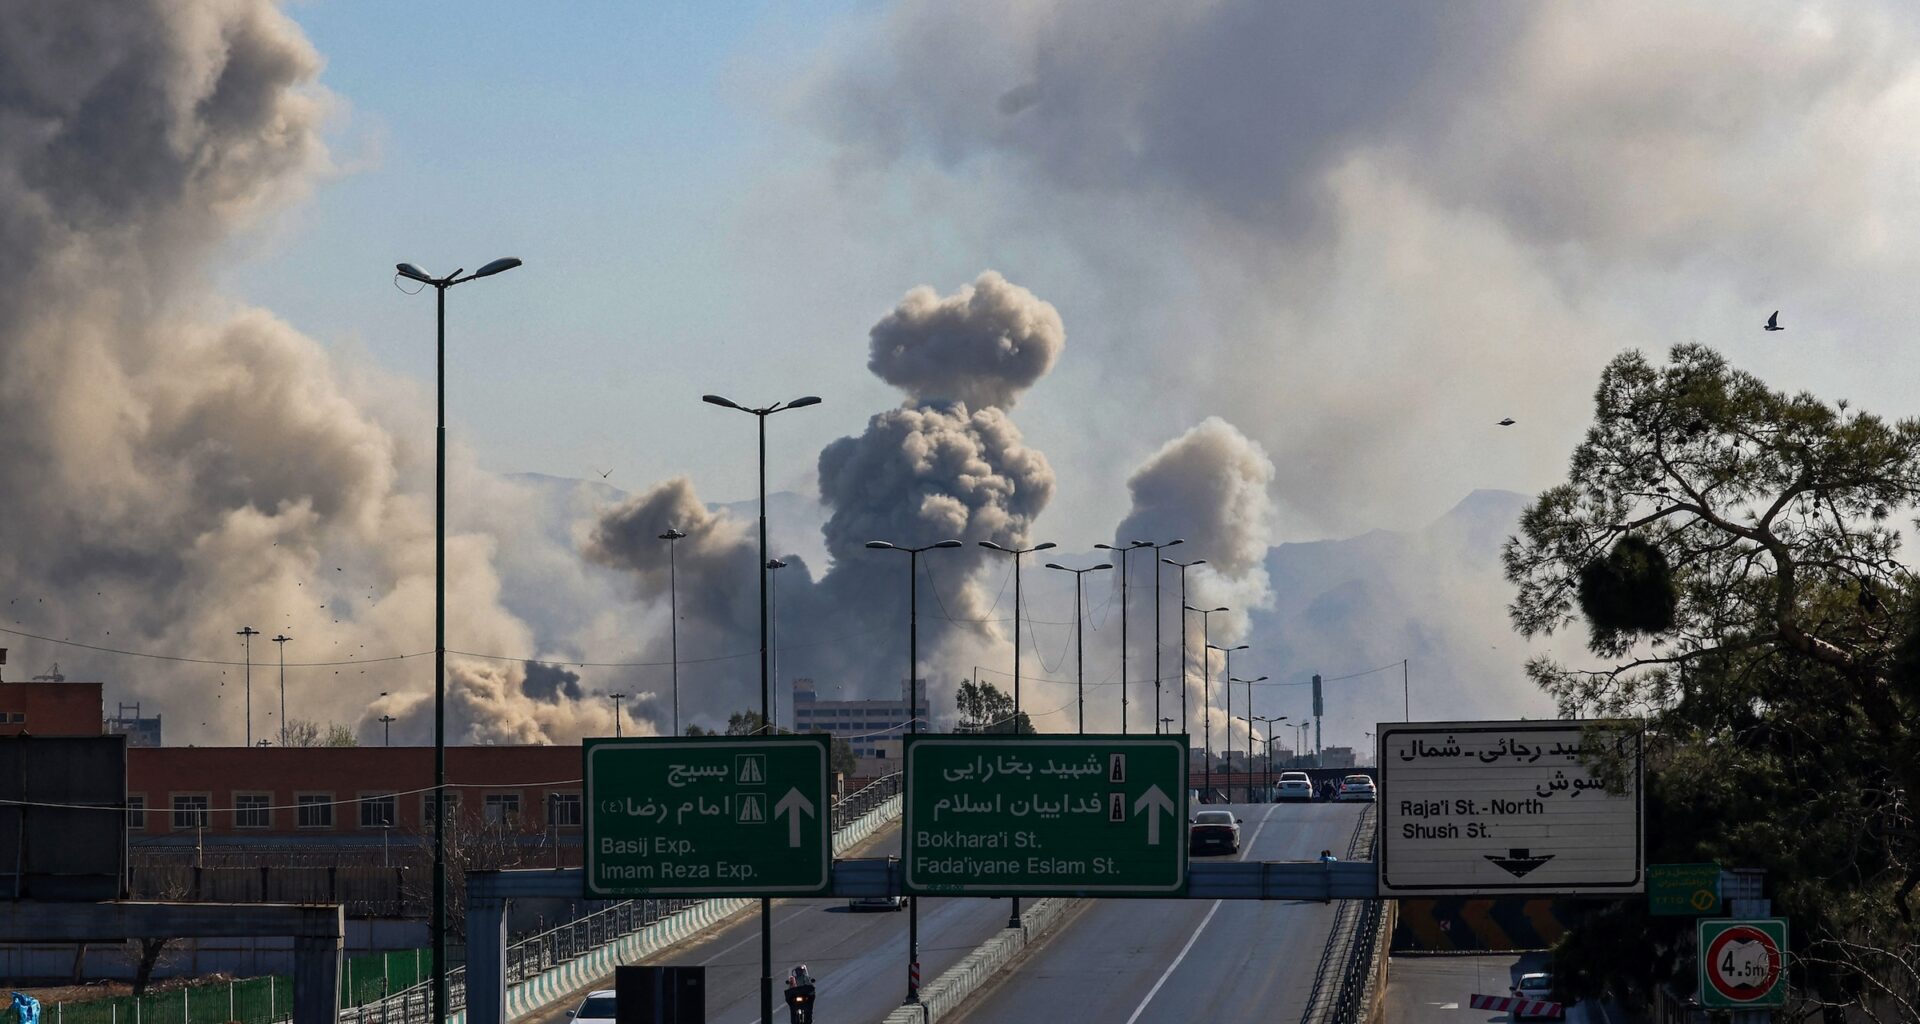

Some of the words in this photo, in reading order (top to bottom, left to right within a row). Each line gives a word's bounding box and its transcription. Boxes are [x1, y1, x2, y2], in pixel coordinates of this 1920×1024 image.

[667, 764, 729, 788] بسیج
[943, 755, 1034, 783] بخارایی
[1039, 753, 1103, 780] شهید
[677, 795, 730, 825] امام
[933, 793, 1001, 822] اسلام
[1010, 792, 1103, 819] فداییان
[1400, 799, 1449, 819] Raja'i
[917, 831, 1008, 848] Bokhara'i
[1014, 831, 1043, 849] St.
[1402, 822, 1459, 839] Shush
[1466, 822, 1492, 839] St.
[601, 837, 648, 857] Basij
[655, 836, 696, 857] Exp.
[601, 863, 654, 879] Imam
[661, 862, 710, 879] Reza
[716, 861, 758, 881] Exp.
[917, 856, 1020, 878] Fada'iyane
[1027, 856, 1086, 874] Eslam
[1092, 857, 1121, 874] St.
